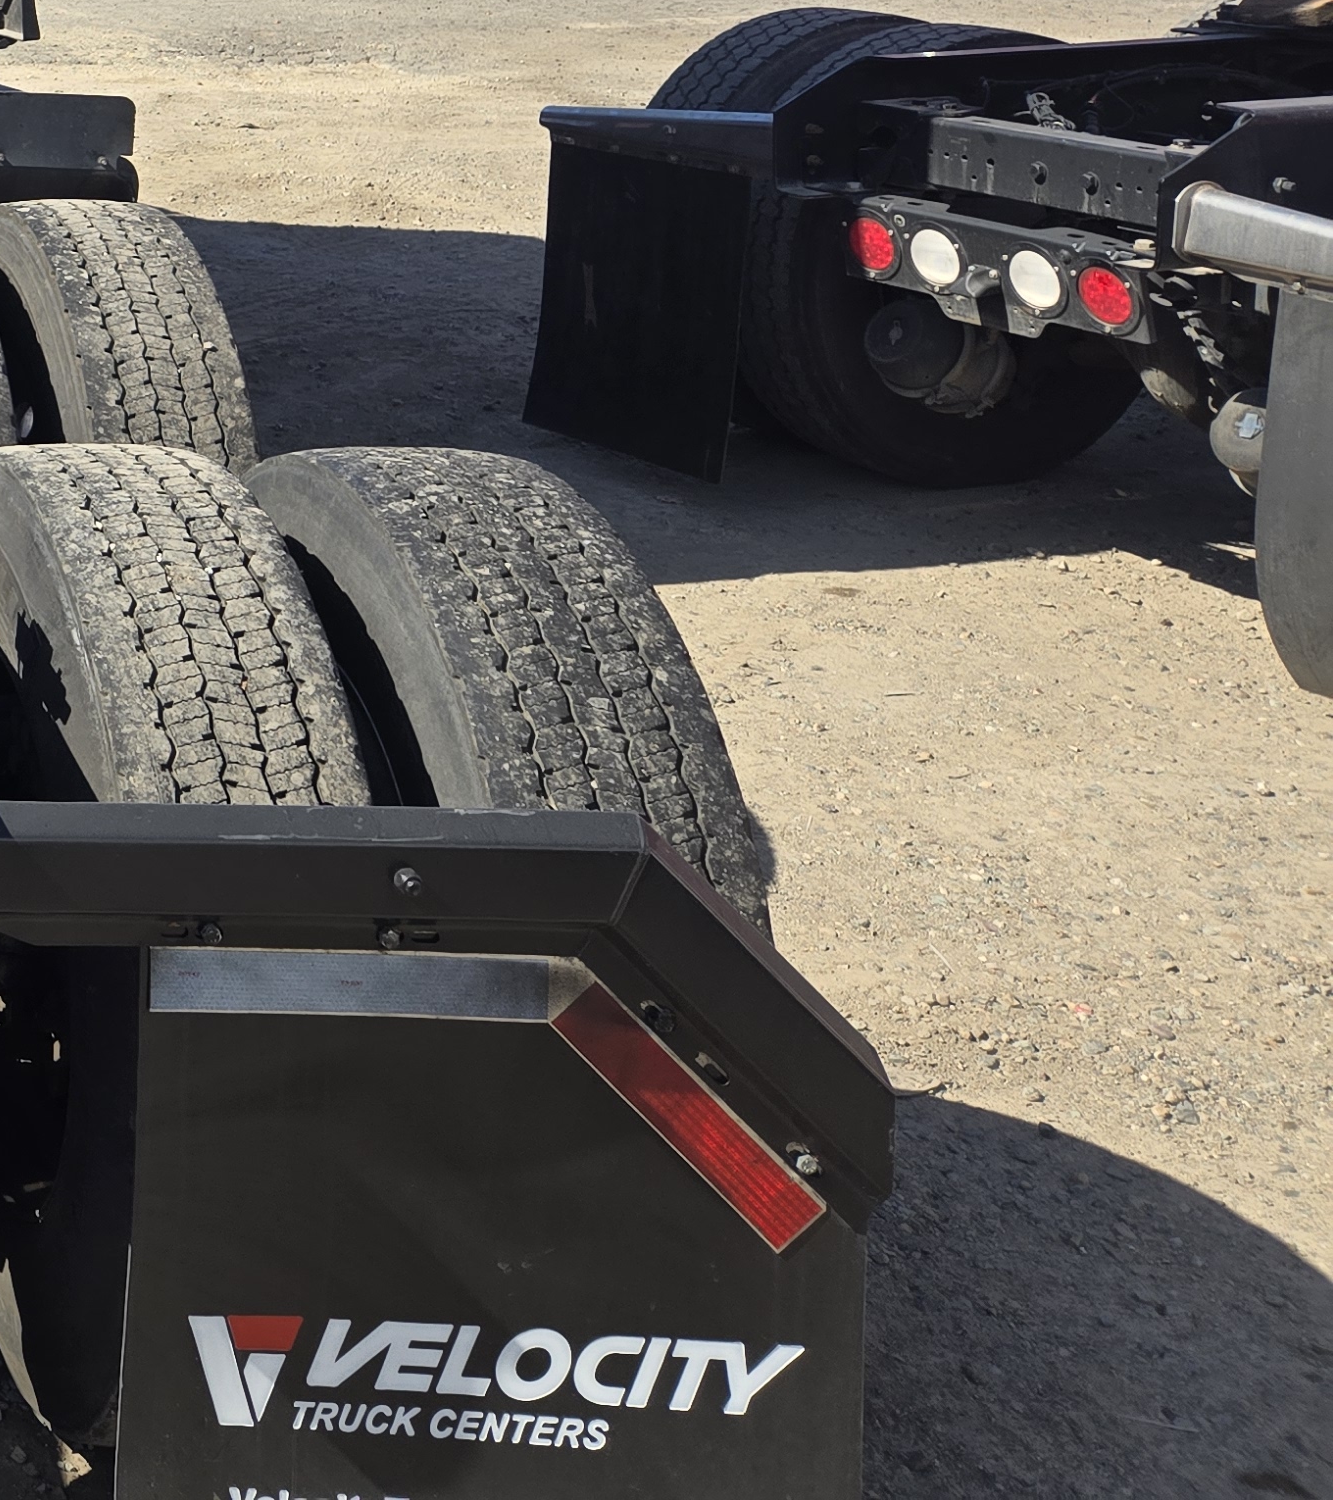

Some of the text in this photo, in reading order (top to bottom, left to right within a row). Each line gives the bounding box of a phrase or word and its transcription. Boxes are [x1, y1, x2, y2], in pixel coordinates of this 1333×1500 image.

[307, 1318, 805, 1416] VELOCITY
[292, 1401, 610, 1452] TRUCK CENTERS
